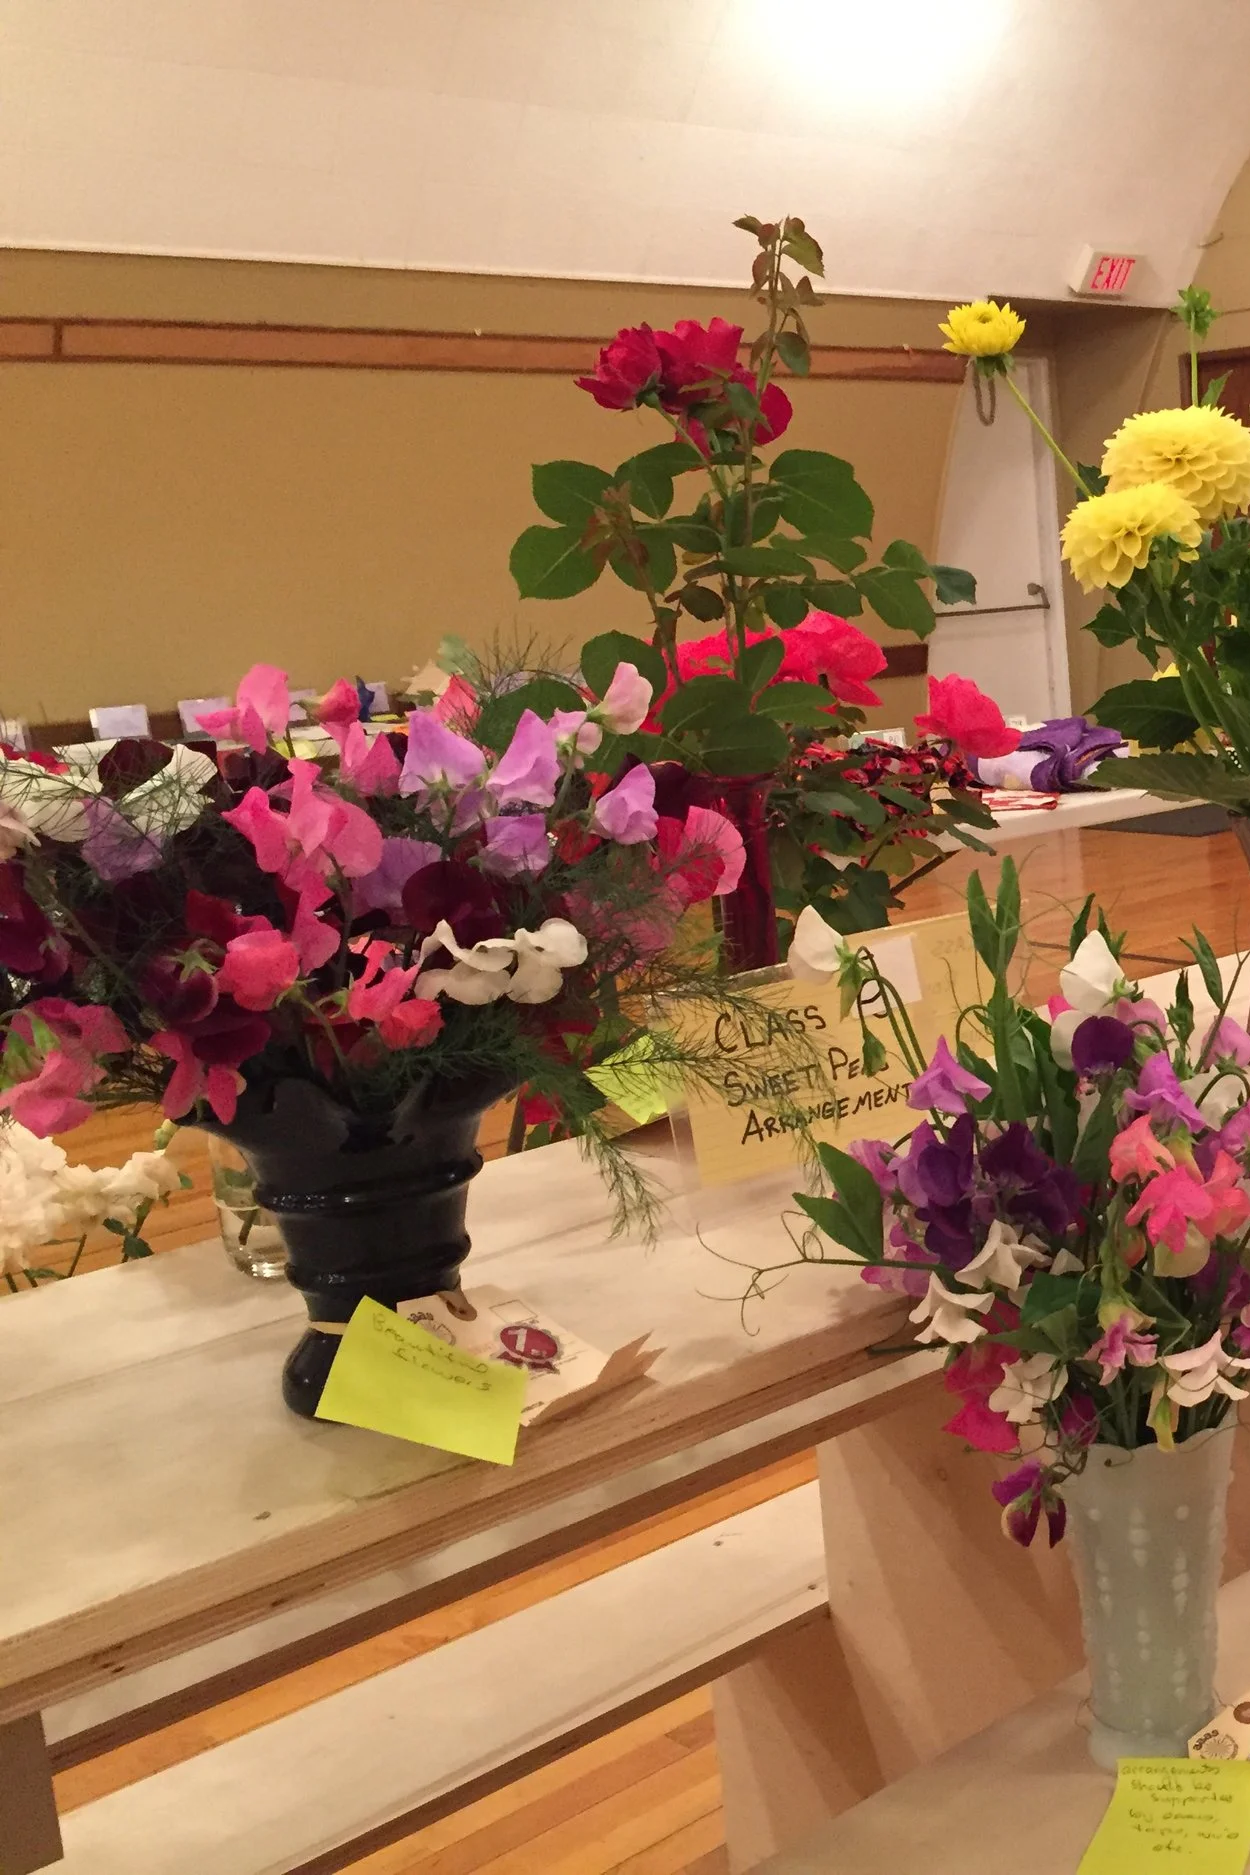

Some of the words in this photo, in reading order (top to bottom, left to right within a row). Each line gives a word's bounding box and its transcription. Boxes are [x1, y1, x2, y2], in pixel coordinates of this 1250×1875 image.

[1090, 256, 1136, 290] EXIT
[714, 1004, 827, 1053] CLASS
[723, 1063, 817, 1108] SWEET
[741, 1082, 913, 1145] ARRANGEMENT
